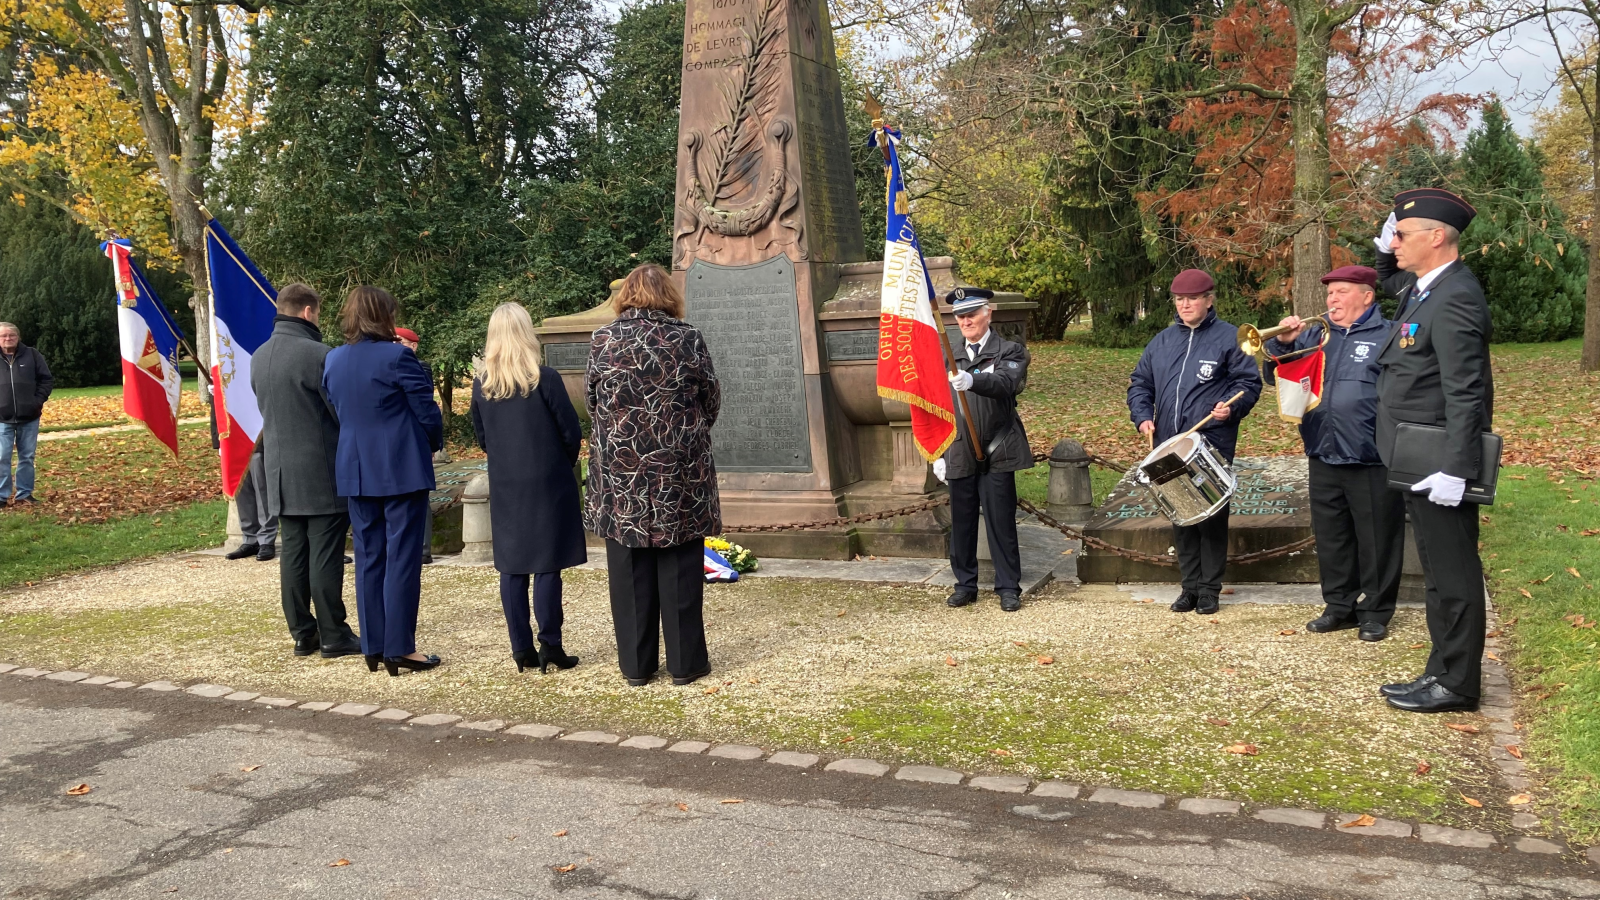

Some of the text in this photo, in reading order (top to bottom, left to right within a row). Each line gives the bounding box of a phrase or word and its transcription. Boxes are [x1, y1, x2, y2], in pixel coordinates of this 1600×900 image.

[686, 42, 701, 53] DE
[880, 215, 915, 360] OFFICE MUNICIP
[900, 355, 919, 384] DES
